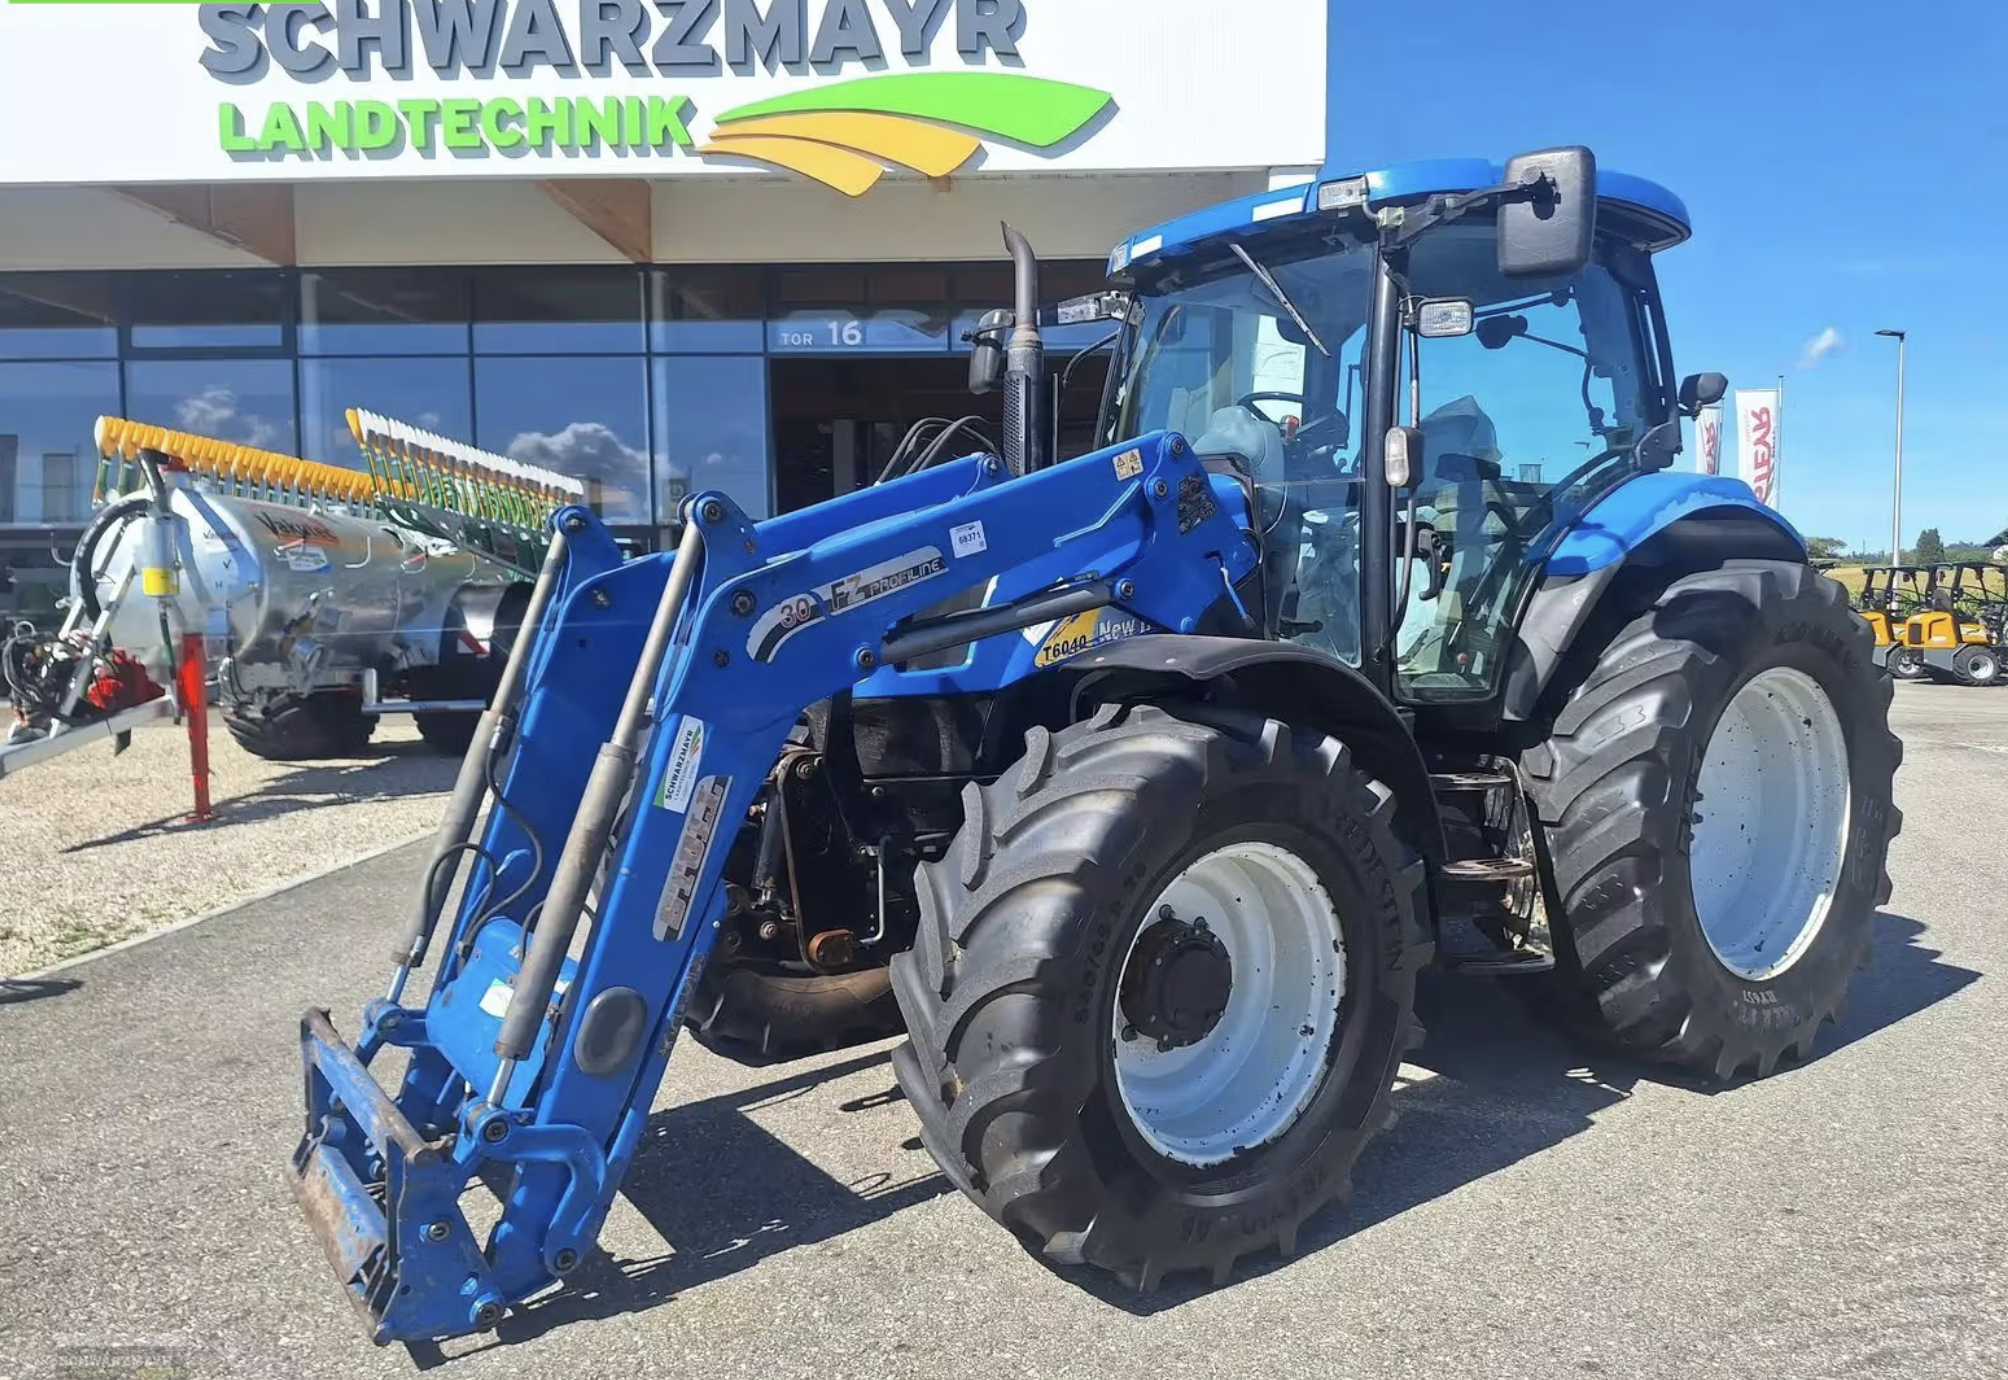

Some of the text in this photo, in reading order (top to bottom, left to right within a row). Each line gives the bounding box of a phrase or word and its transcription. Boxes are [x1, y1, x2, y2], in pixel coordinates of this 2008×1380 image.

[198, 0, 1026, 74] SCHWARZMAYR
[218, 96, 694, 151] LANDTECHNIK
[781, 321, 862, 345] TOR 16
[958, 531, 981, 544] 68371
[780, 597, 812, 629] 30
[1043, 635, 1088, 661] T6040
[665, 730, 694, 800] SCHWARZMAYR
